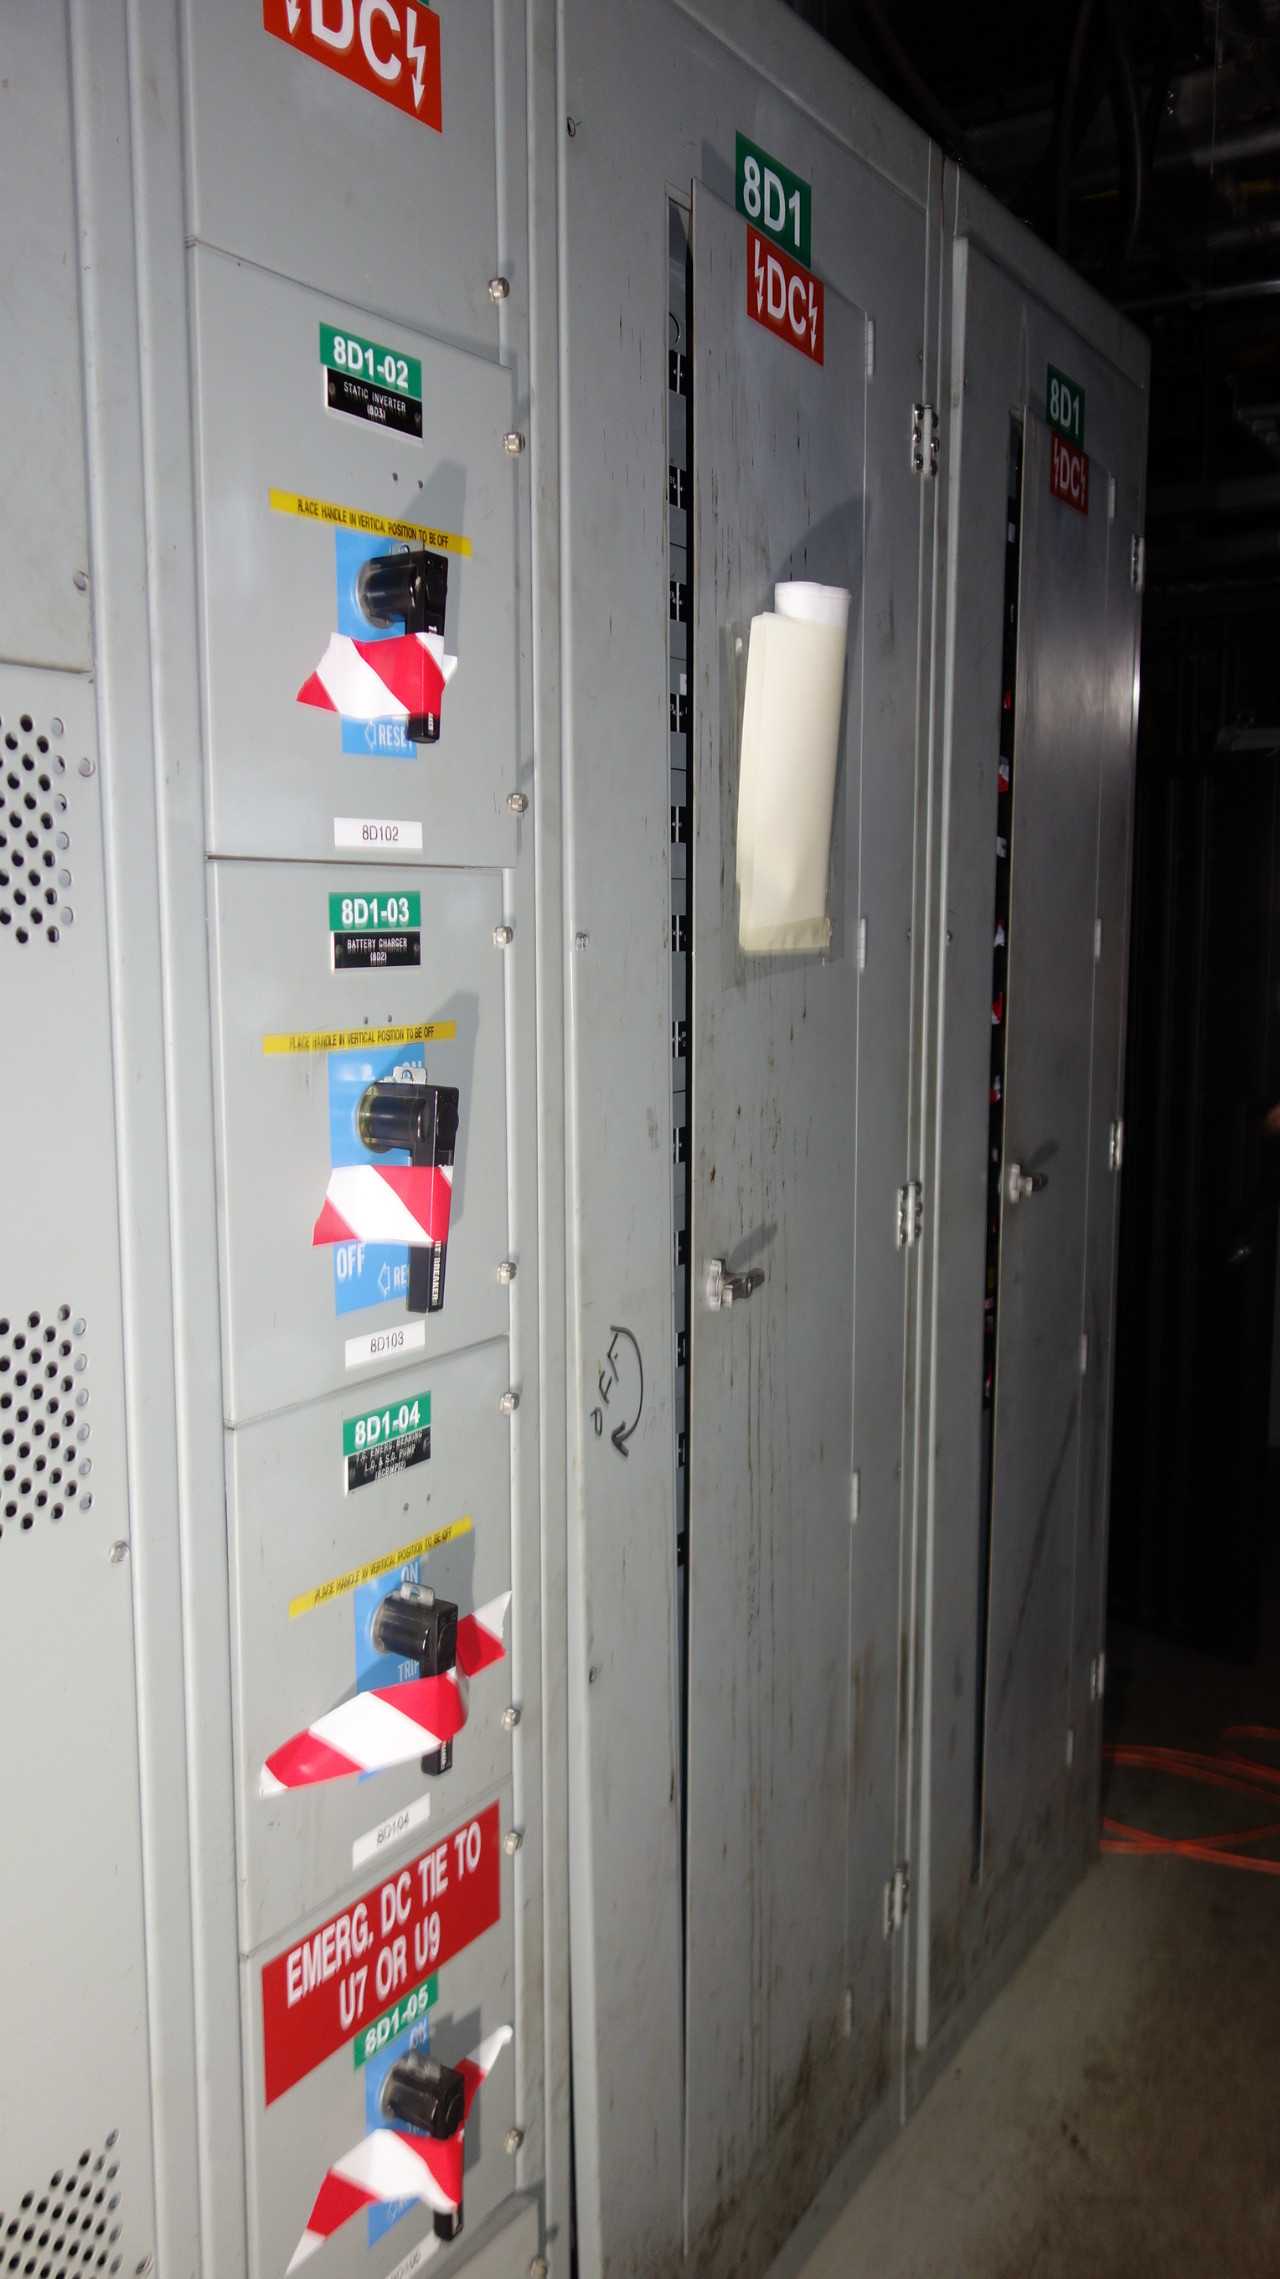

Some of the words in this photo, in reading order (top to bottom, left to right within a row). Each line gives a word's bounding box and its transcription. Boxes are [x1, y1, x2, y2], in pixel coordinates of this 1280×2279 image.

[311, 0, 401, 80] DC
[743, 156, 800, 247] 8D1
[767, 255, 806, 334] DC
[333, 335, 409, 389] 8D1-02
[344, 381, 368, 399] STATIC
[372, 392, 406, 413] INVERTER
[1050, 378, 1079, 437] 8D1
[1060, 447, 1080, 497] DC
[298, 499, 319, 516] PLACE
[321, 503, 347, 523] HANDLE
[350, 511, 357, 525] IN
[388, 521, 417, 540] POSITION
[419, 529, 427, 544] TO
[429, 533, 436, 546] BE
[437, 535, 449, 548] OFF
[378, 723, 412, 748] RESE
[362, 824, 399, 841] 8D102
[342, 898, 409, 925] 8D1-03
[347, 938, 376, 950] BATTERY
[379, 938, 407, 949] CHARGER
[347, 1031, 375, 1045] VERTICAL
[377, 1028, 404, 1042] POSITION
[414, 1027, 424, 1039] BE
[424, 1026, 435, 1038] OFF
[337, 1243, 365, 1279] OFF
[432, 1257, 441, 1304] BREAKER
[370, 1331, 404, 1353] 8D103
[355, 1400, 420, 1446] 8D1-04
[401, 1560, 418, 1584] ON
[398, 1659, 419, 1682] TRIP
[375, 1813, 409, 1844] 8D104
[286, 1903, 374, 2008] EMERG.
[381, 1871, 411, 1938] DC
[418, 1844, 448, 1907] TIE
[454, 1822, 481, 1881] TO
[339, 1965, 368, 2030] U7
[376, 1936, 407, 2001] OR
[415, 1912, 440, 1970] U9
[365, 1984, 429, 2055] 8D1-05
